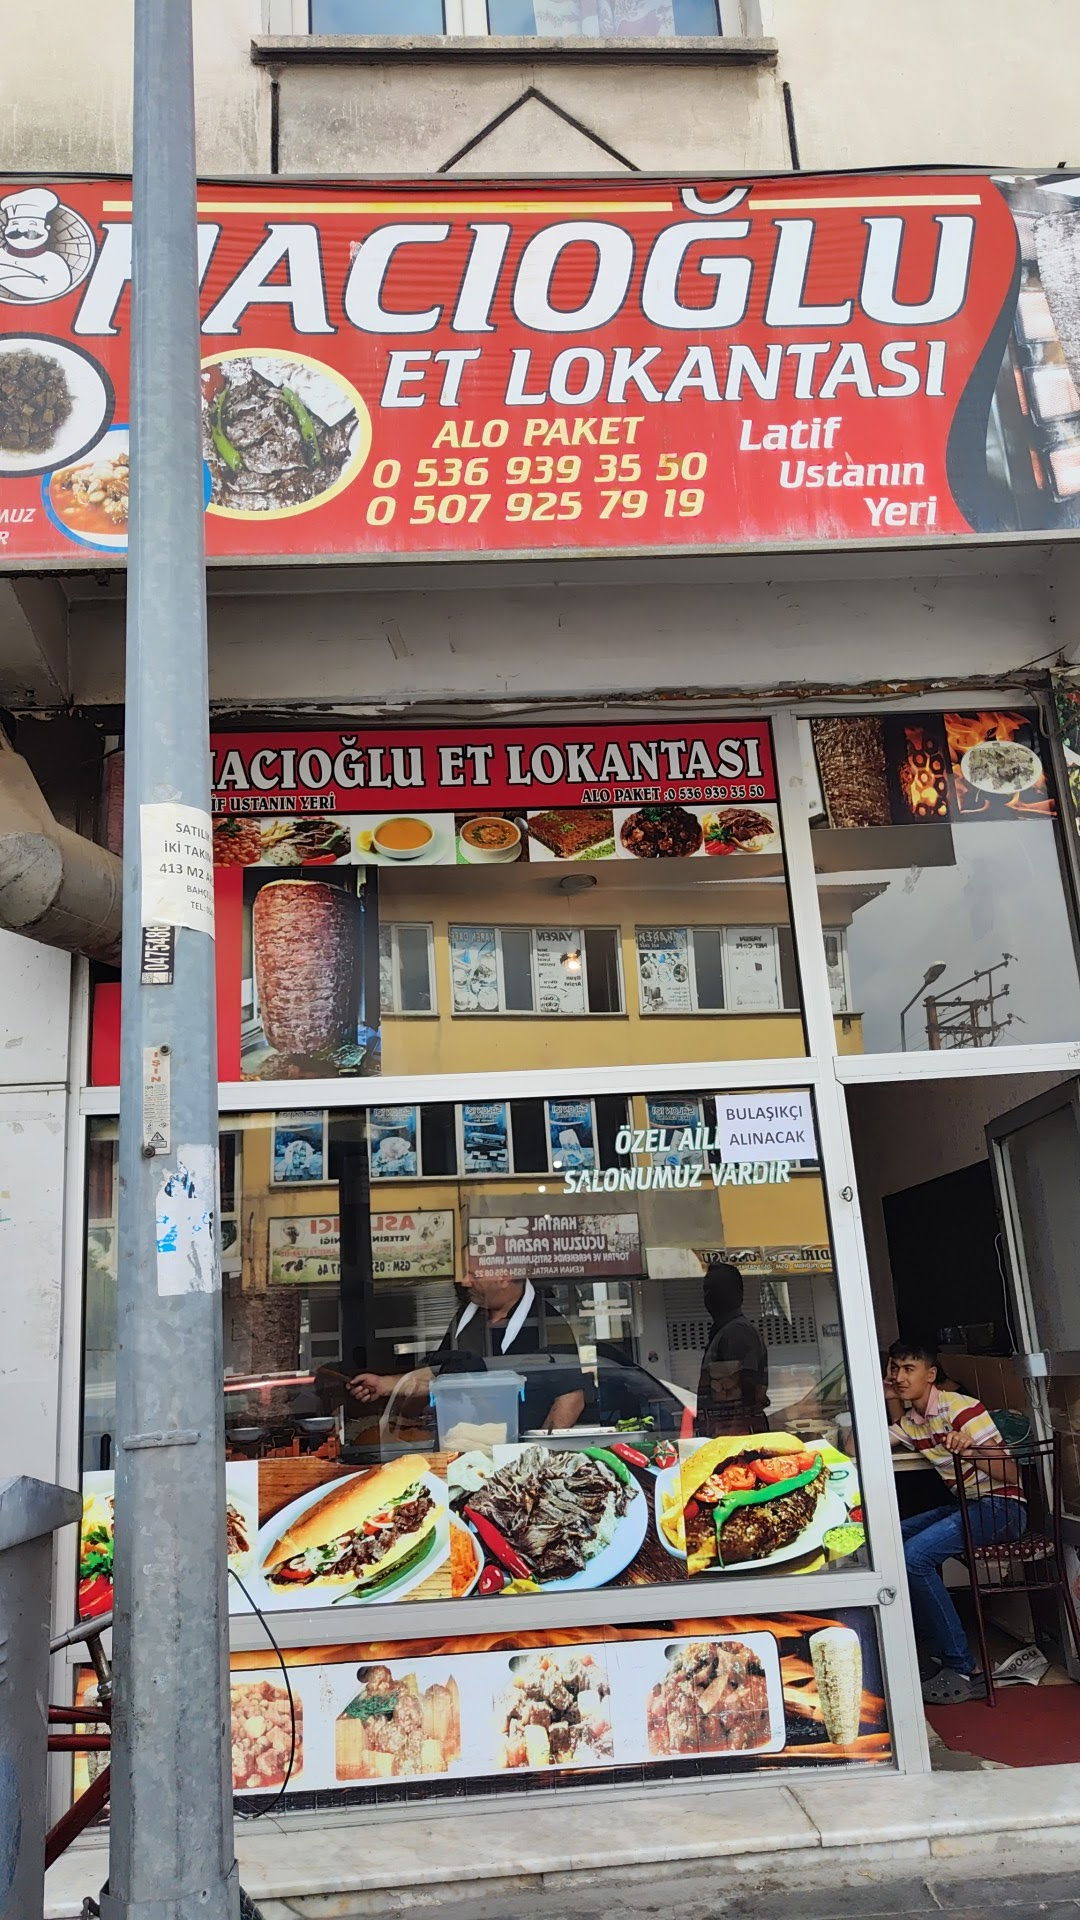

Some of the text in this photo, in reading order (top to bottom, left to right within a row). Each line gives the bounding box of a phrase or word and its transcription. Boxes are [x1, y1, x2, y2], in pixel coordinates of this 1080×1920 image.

[380, 340, 947, 408] ET LOKANTASI
[431, 415, 645, 449] ALO PAKET
[739, 416, 842, 451] Latif
[372, 451, 708, 489] 0 536 939 35 50
[778, 460, 925, 489] Ustanın
[365, 488, 705, 526] 0 507 925 79 19
[864, 497, 938, 527] Yeri
[211, 736, 763, 791] ACIOĞLU ET LOKANTASI
[231, 796, 296, 811] USTANIN
[299, 792, 336, 810] YERİ
[580, 788, 610, 804] ALO
[614, 787, 662, 803] PAKET
[678, 786, 701, 802] 536
[704, 786, 727, 801] 939
[729, 785, 746, 800] 35
[749, 785, 765, 799] 50
[164, 840, 181, 853] İKİ
[159, 863, 183, 874] 413
[187, 865, 204, 880] M2
[725, 1104, 803, 1122] BULAŞIKÇI
[615, 1125, 671, 1155] ÖZEL
[728, 1128, 806, 1147] ALINACAK
[563, 1160, 791, 1195] SALONUMUZ VARDIR
